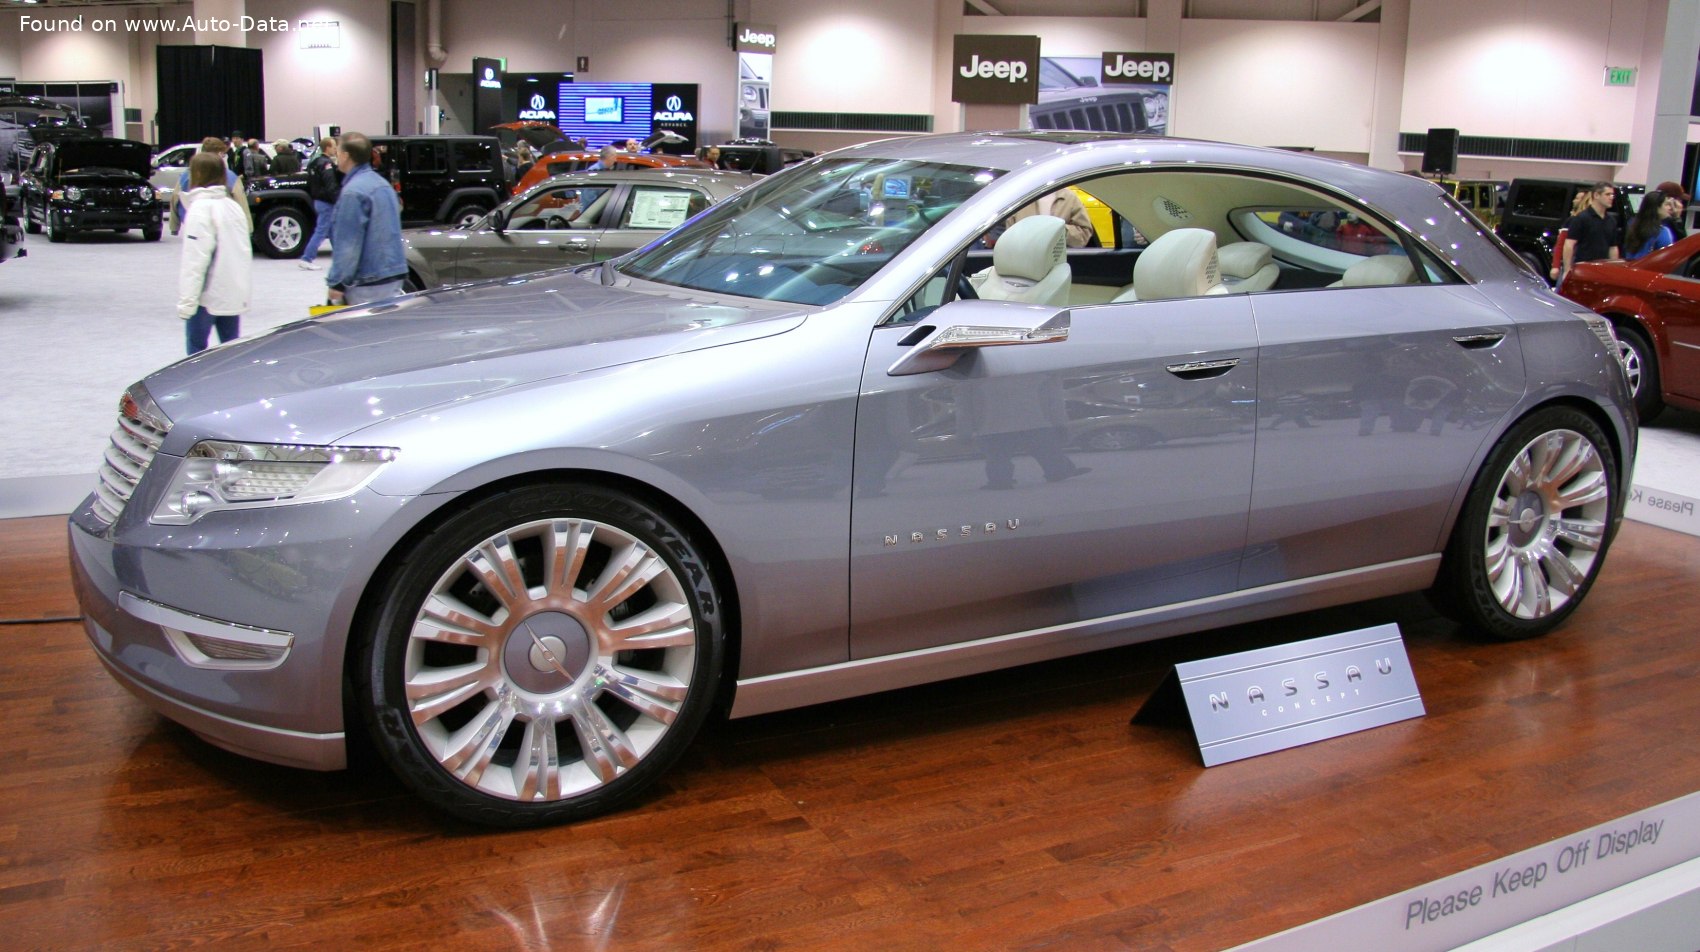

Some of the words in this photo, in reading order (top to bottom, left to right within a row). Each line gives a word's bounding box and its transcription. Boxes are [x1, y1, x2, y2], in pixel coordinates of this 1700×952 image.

[740, 29, 775, 47] Jeep
[960, 55, 1027, 83] Jeep
[1105, 55, 1170, 82] Jeep
[1610, 70, 1632, 84] EXIT
[519, 110, 556, 119] ACURA
[653, 112, 693, 121] ACURA
[884, 518, 1020, 547] NASSAU
[1209, 657, 1392, 711] NASSAU
[1261, 688, 1360, 716] CONCEPT
[1405, 885, 1483, 930] Please
[1492, 862, 1547, 898] Keep
[1557, 840, 1590, 873] Off
[1597, 819, 1664, 860] Display
